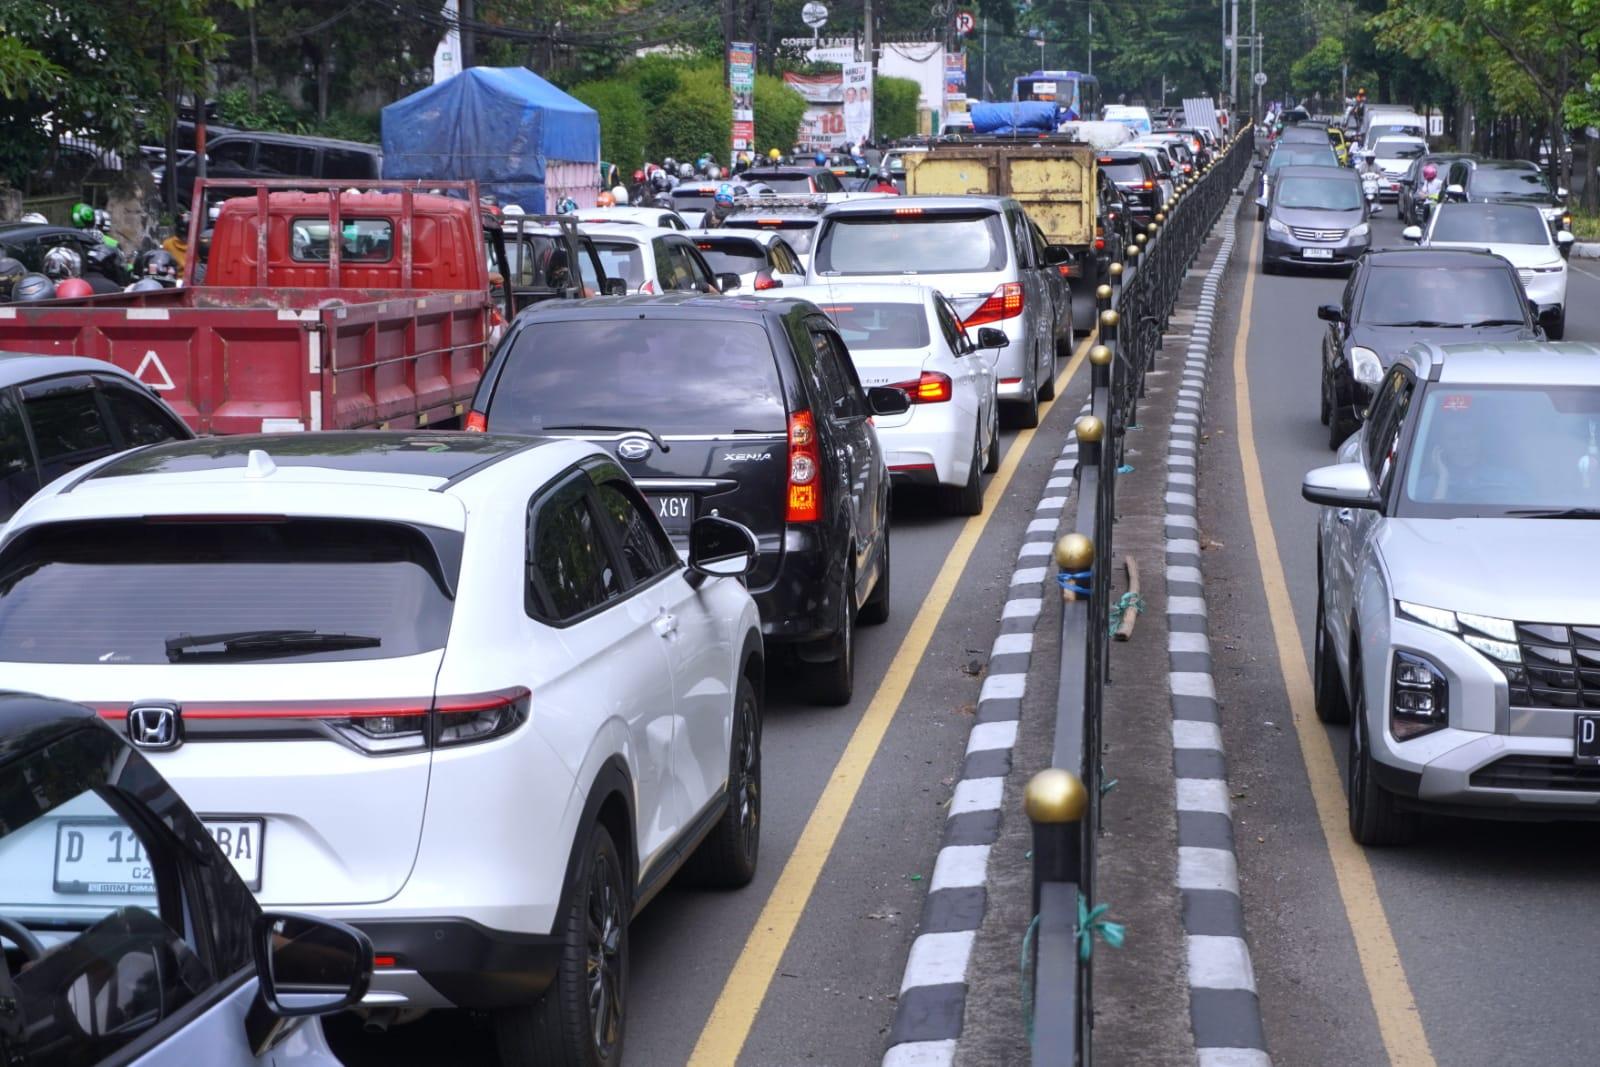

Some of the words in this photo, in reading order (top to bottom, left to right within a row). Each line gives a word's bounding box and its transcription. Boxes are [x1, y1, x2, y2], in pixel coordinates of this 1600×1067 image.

[780, 37, 816, 47] COFFEE
[723, 452, 771, 461] XENIA
[659, 497, 689, 517] XGY
[1582, 719, 1595, 743] D
[65, 830, 84, 863] D
[207, 826, 252, 859] BA
